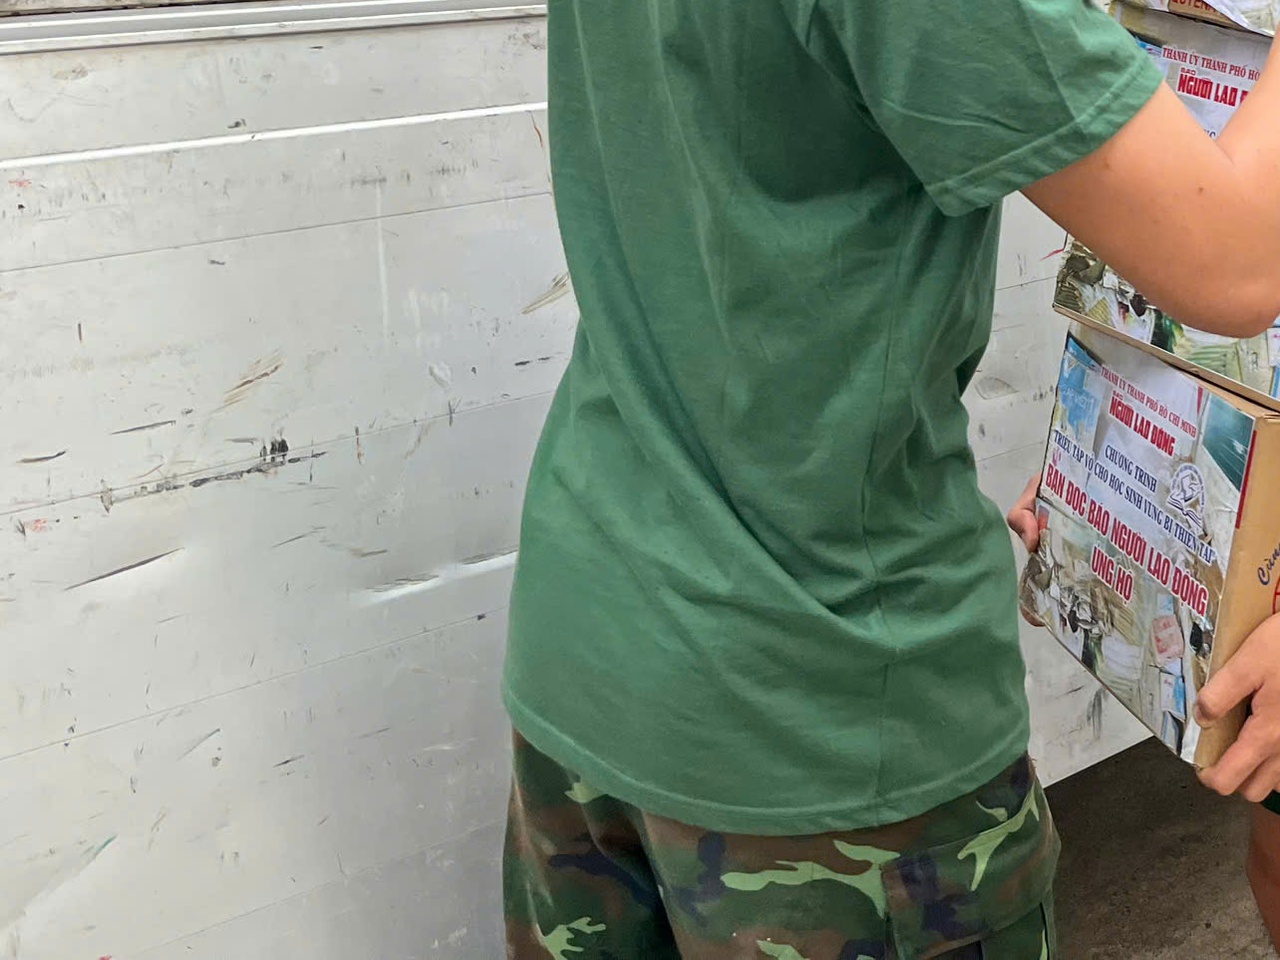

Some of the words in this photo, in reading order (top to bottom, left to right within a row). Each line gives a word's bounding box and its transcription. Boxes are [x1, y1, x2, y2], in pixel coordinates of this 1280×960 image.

[1229, 64, 1248, 77] PHỐ
[1214, 83, 1238, 106] LAO
[1134, 413, 1150, 440] LAO
[1181, 419, 1197, 438] MINH
[1094, 460, 1108, 484] CHO
[1109, 472, 1125, 495] HỌC
[1125, 485, 1143, 511] SINH
[1065, 479, 1087, 516] ĐỌC
[1147, 547, 1171, 586] LAO
[1173, 565, 1209, 617] ĐỘNG
[1116, 566, 1133, 604] HỘ
